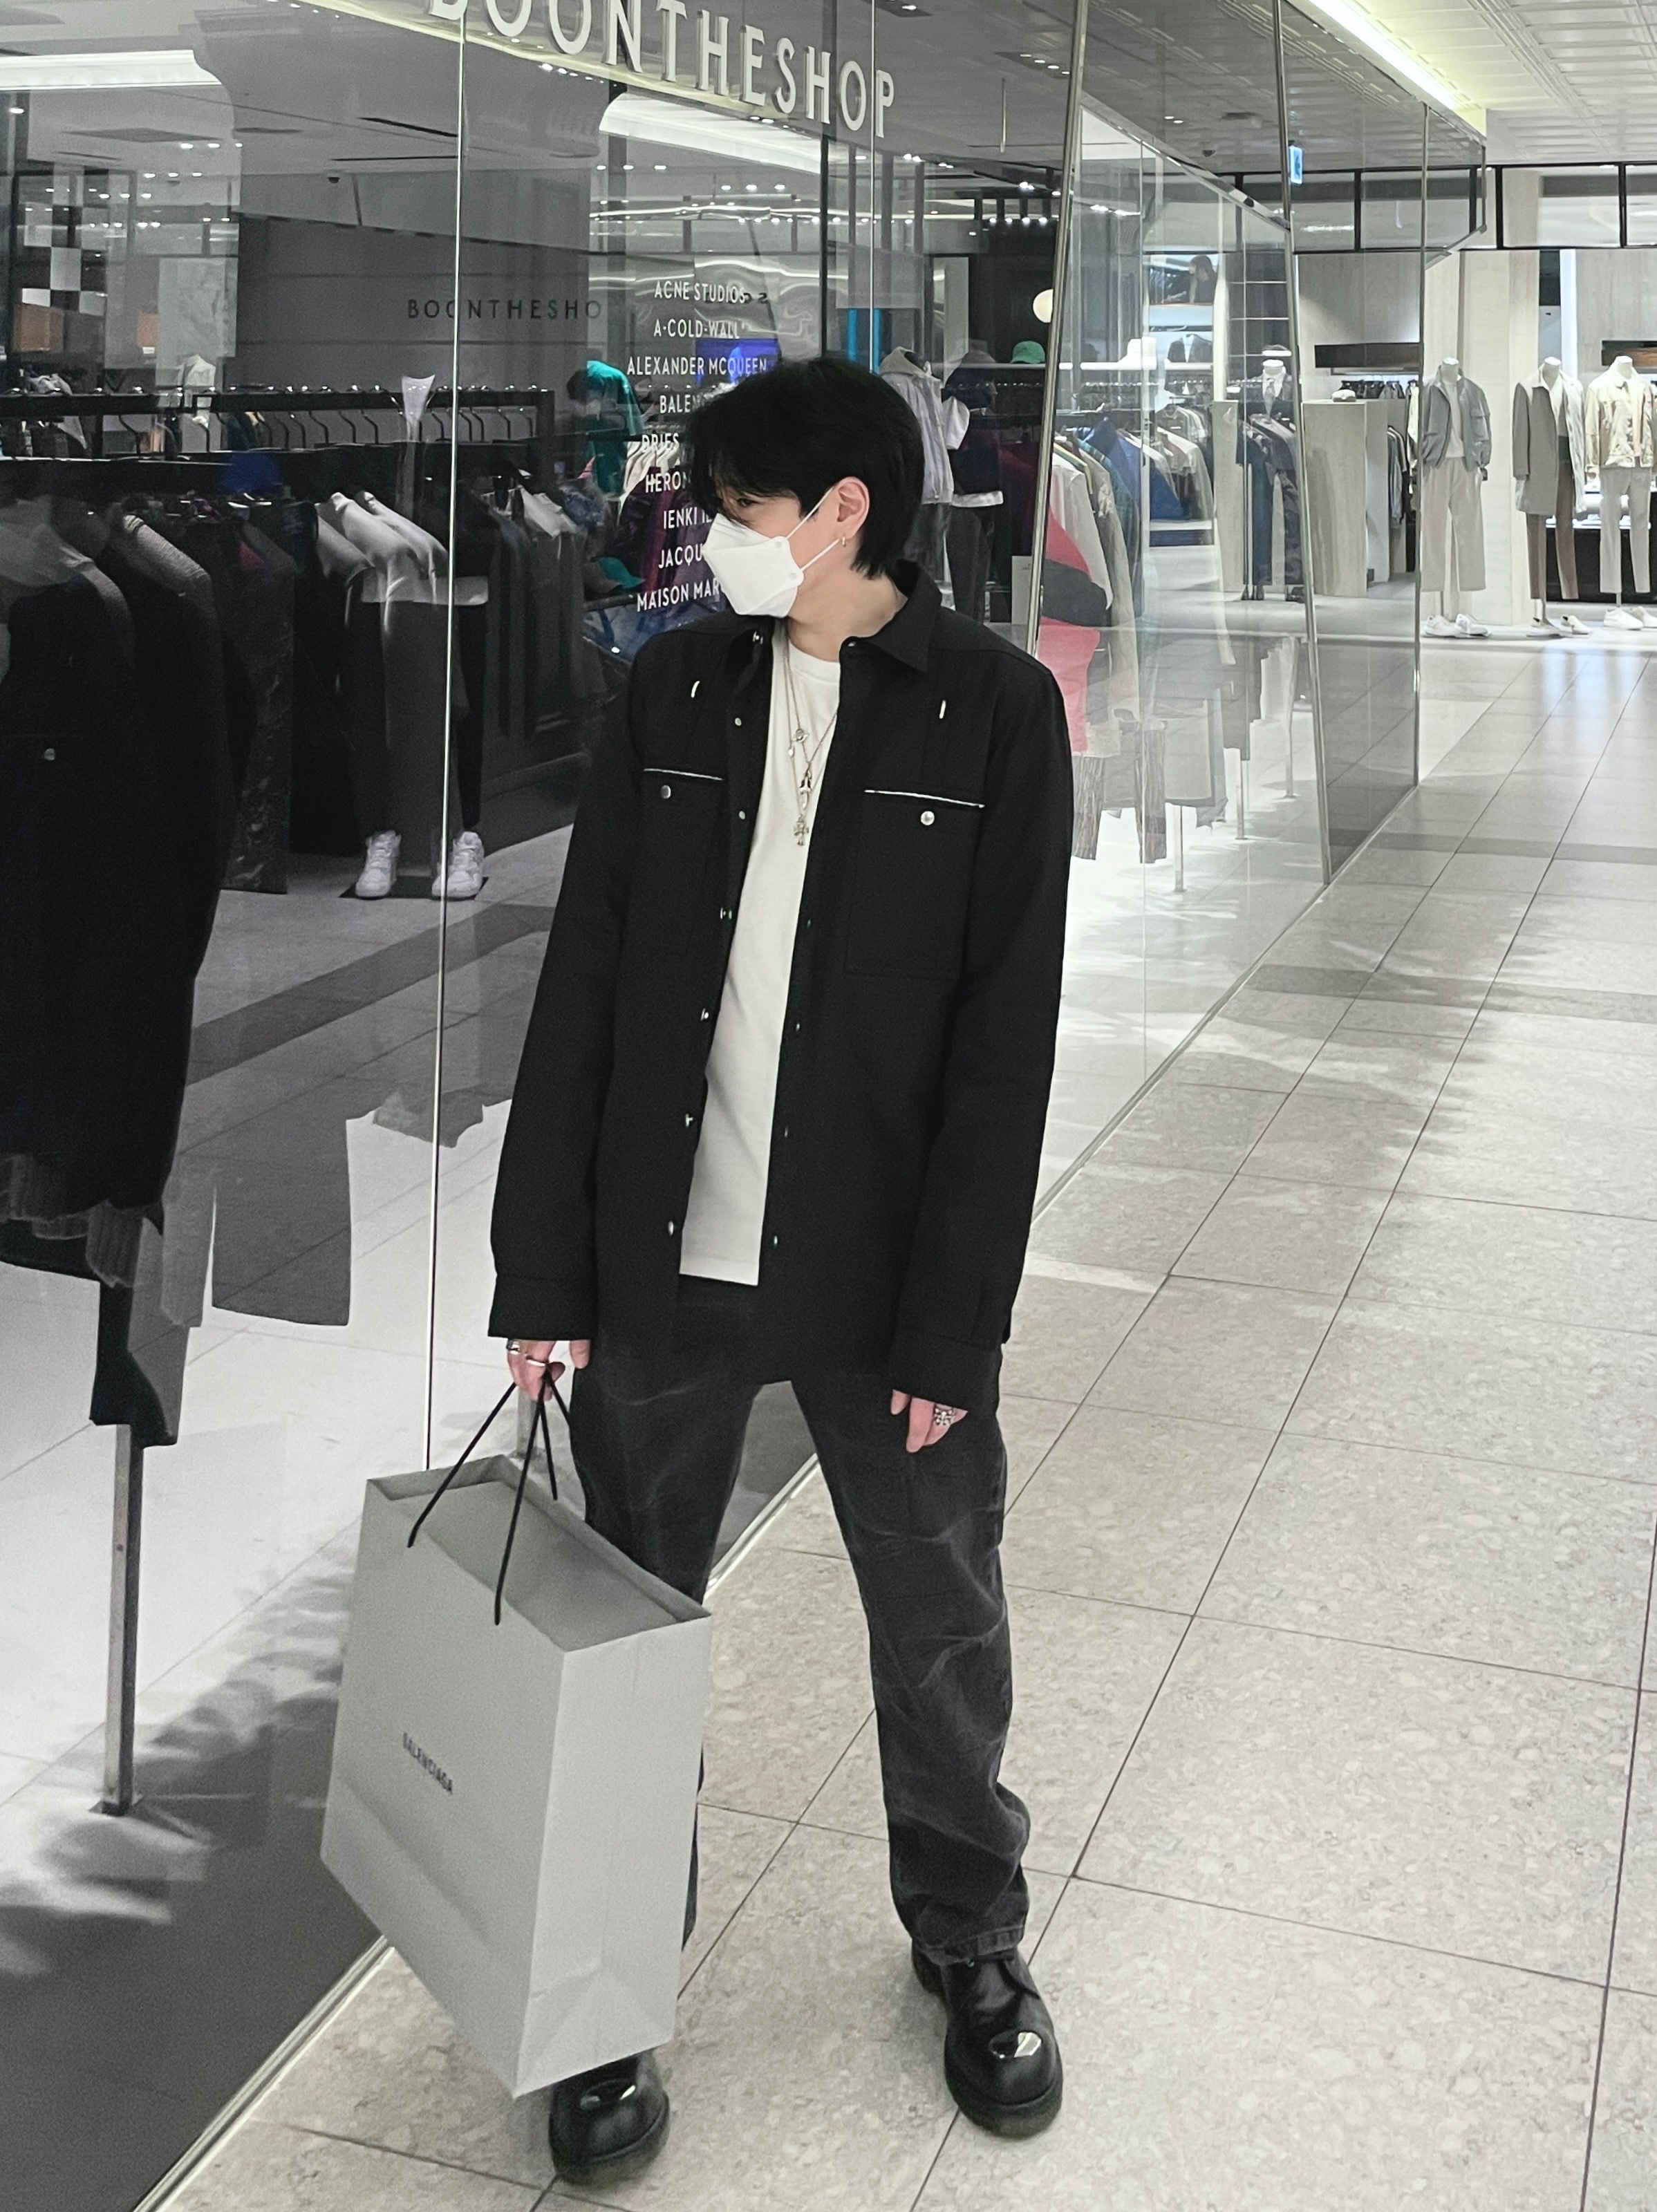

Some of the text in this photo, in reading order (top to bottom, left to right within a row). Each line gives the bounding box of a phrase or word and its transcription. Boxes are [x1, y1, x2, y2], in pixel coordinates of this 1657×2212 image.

[654, 280, 690, 300] ACNE
[693, 283, 746, 303] STUDIOS
[627, 356, 767, 378] ALEXANDER MCQUEEN
[637, 583, 690, 612] MAISON
